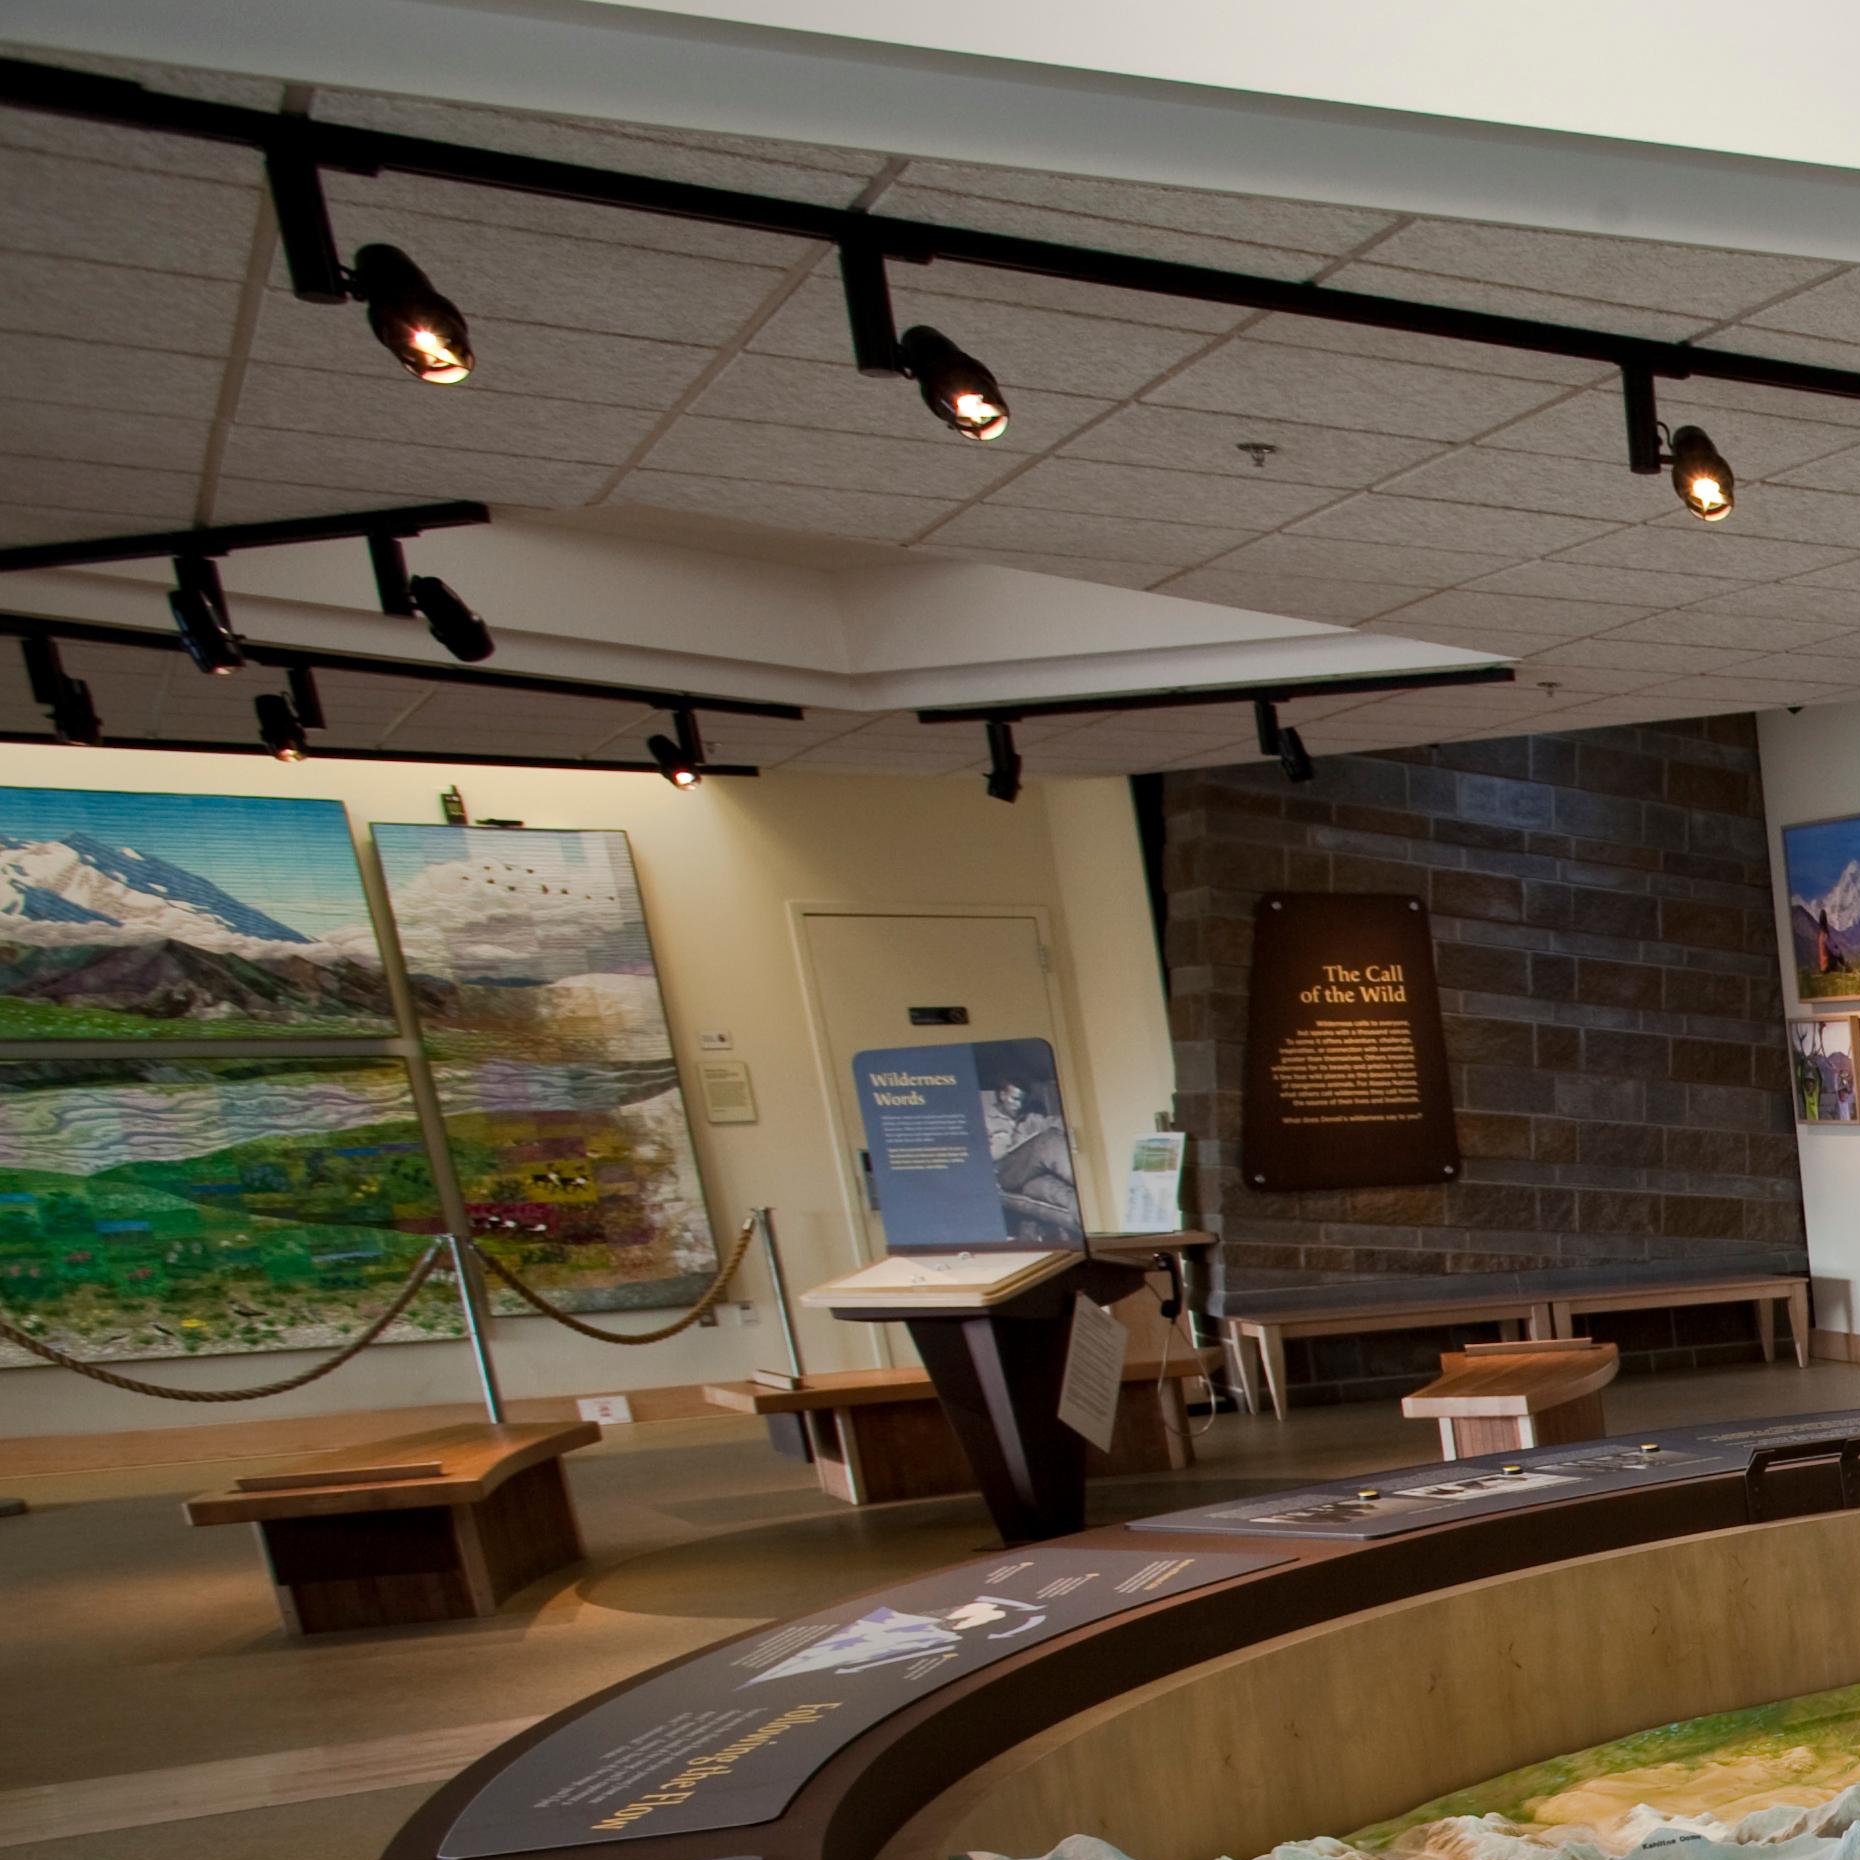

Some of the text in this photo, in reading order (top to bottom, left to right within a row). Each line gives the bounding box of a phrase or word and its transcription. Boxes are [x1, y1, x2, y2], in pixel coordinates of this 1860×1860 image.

[1323, 965, 1404, 983] The Call
[1300, 985, 1407, 1003] of the Wild
[869, 1071, 957, 1088] Wilderness
[873, 1091, 926, 1107] Words
[590, 1701, 843, 1830] Following the Flow
